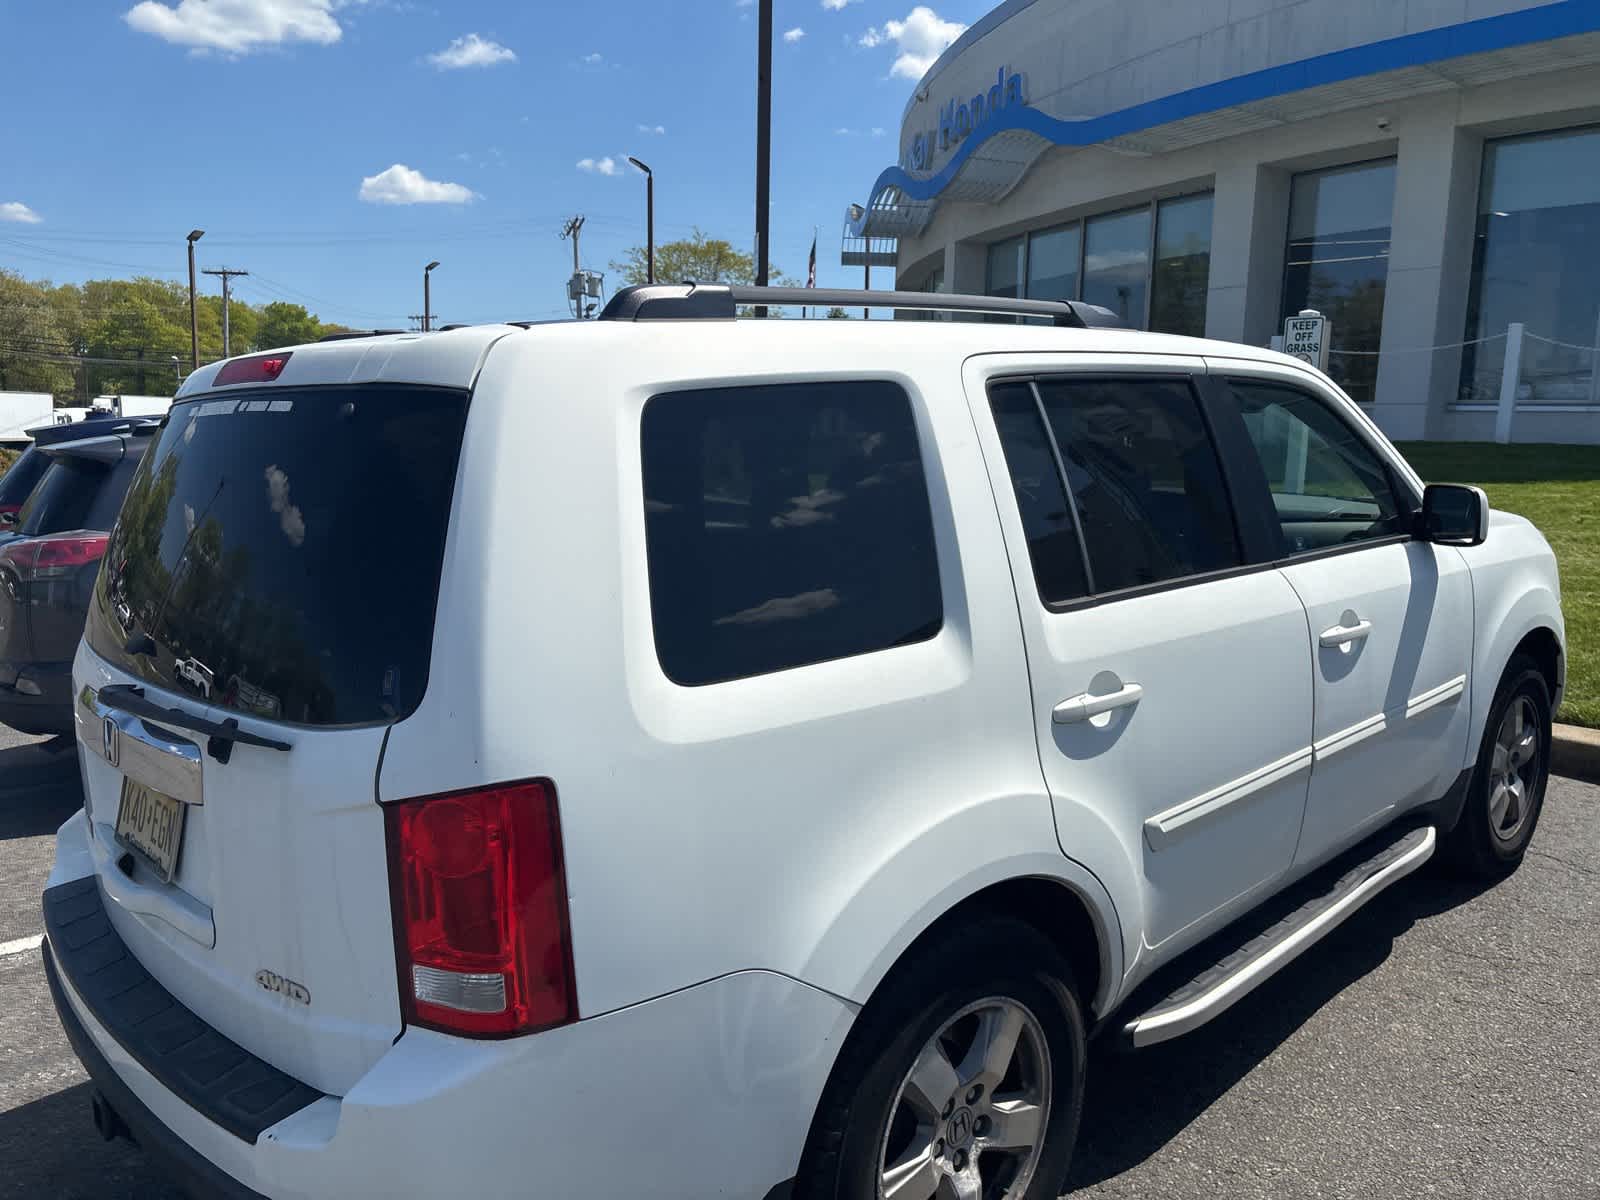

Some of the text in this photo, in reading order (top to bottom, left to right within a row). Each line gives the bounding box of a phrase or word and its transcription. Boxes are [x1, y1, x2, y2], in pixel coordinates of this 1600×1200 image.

[938, 65, 1022, 150] Honda
[1292, 320, 1318, 330] KEEP
[1294, 332, 1313, 341] OFF
[1286, 343, 1319, 352] GRASS
[255, 969, 312, 1006] 4WD
